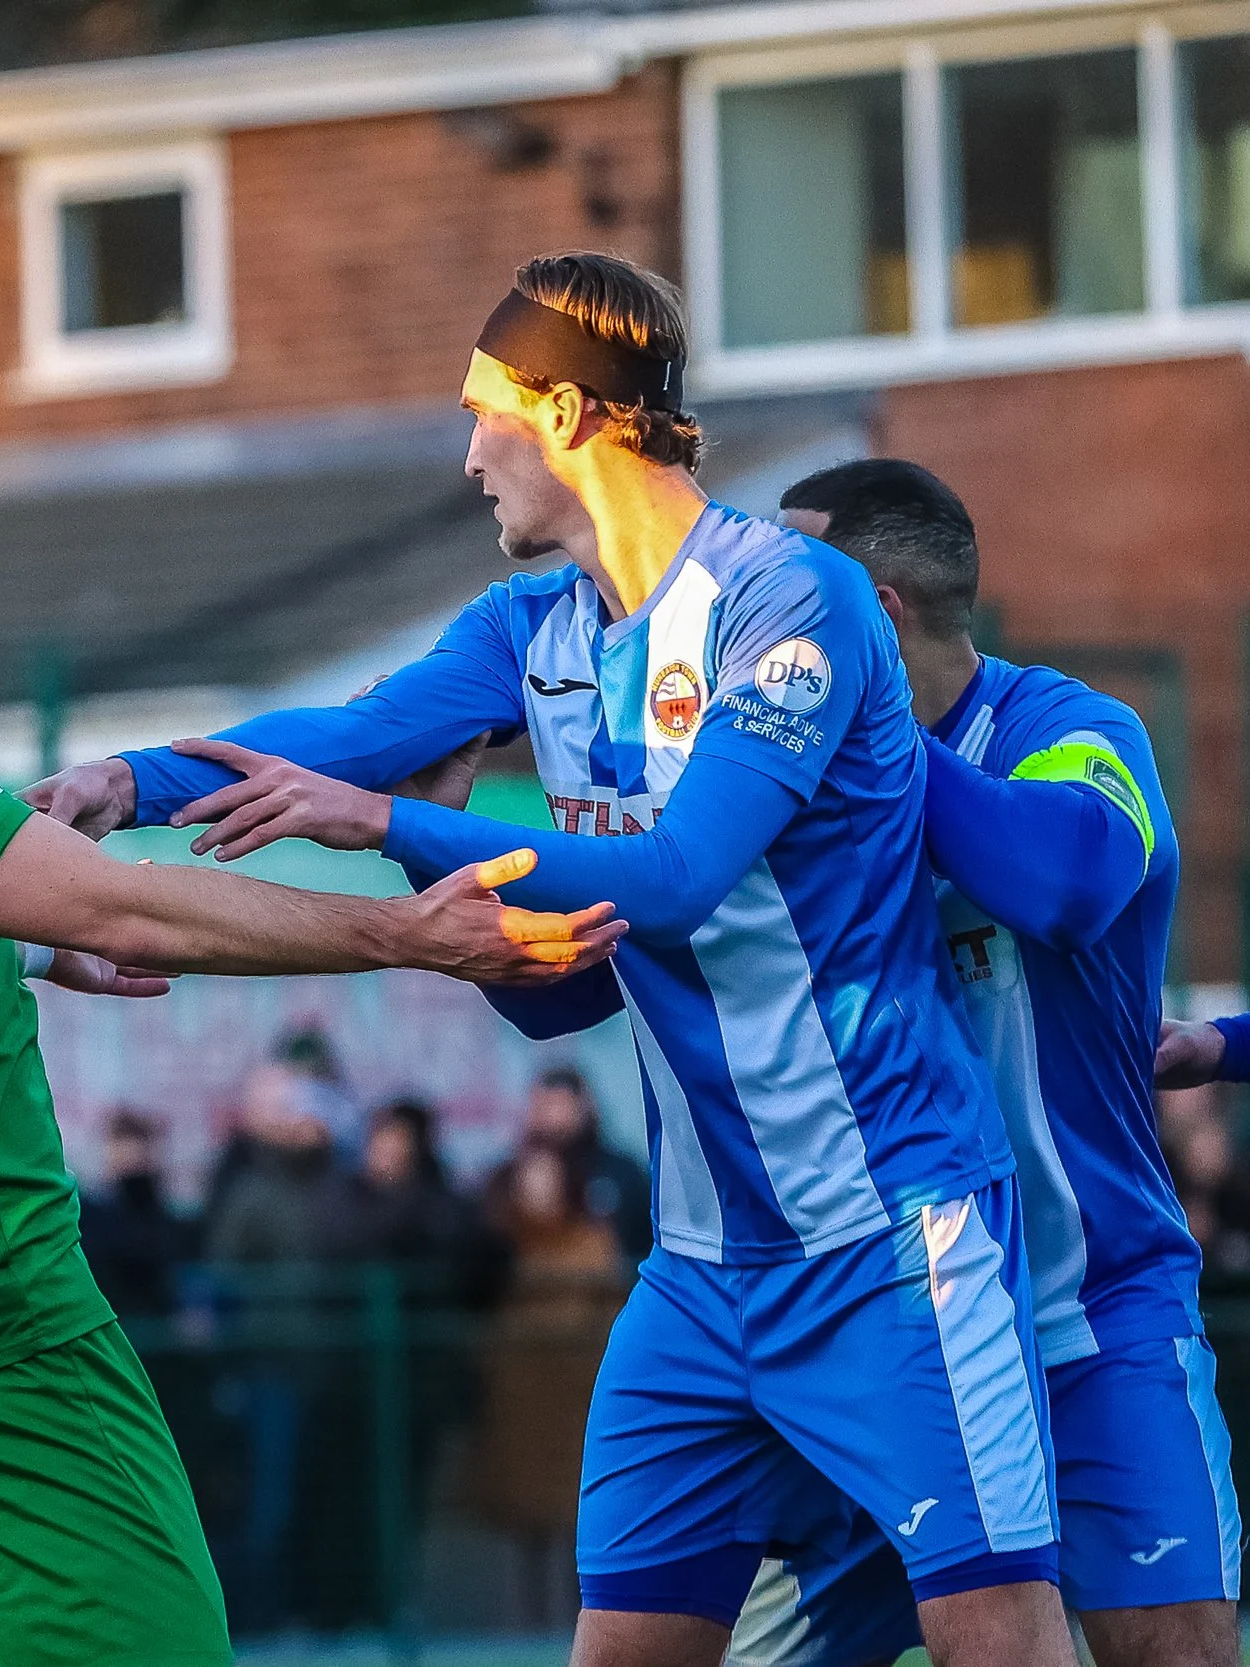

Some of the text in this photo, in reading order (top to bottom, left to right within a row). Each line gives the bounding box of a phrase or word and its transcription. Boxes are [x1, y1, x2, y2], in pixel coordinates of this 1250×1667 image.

[721, 694, 787, 726] FINANCIAL
[733, 715, 806, 754] & SERVICES
